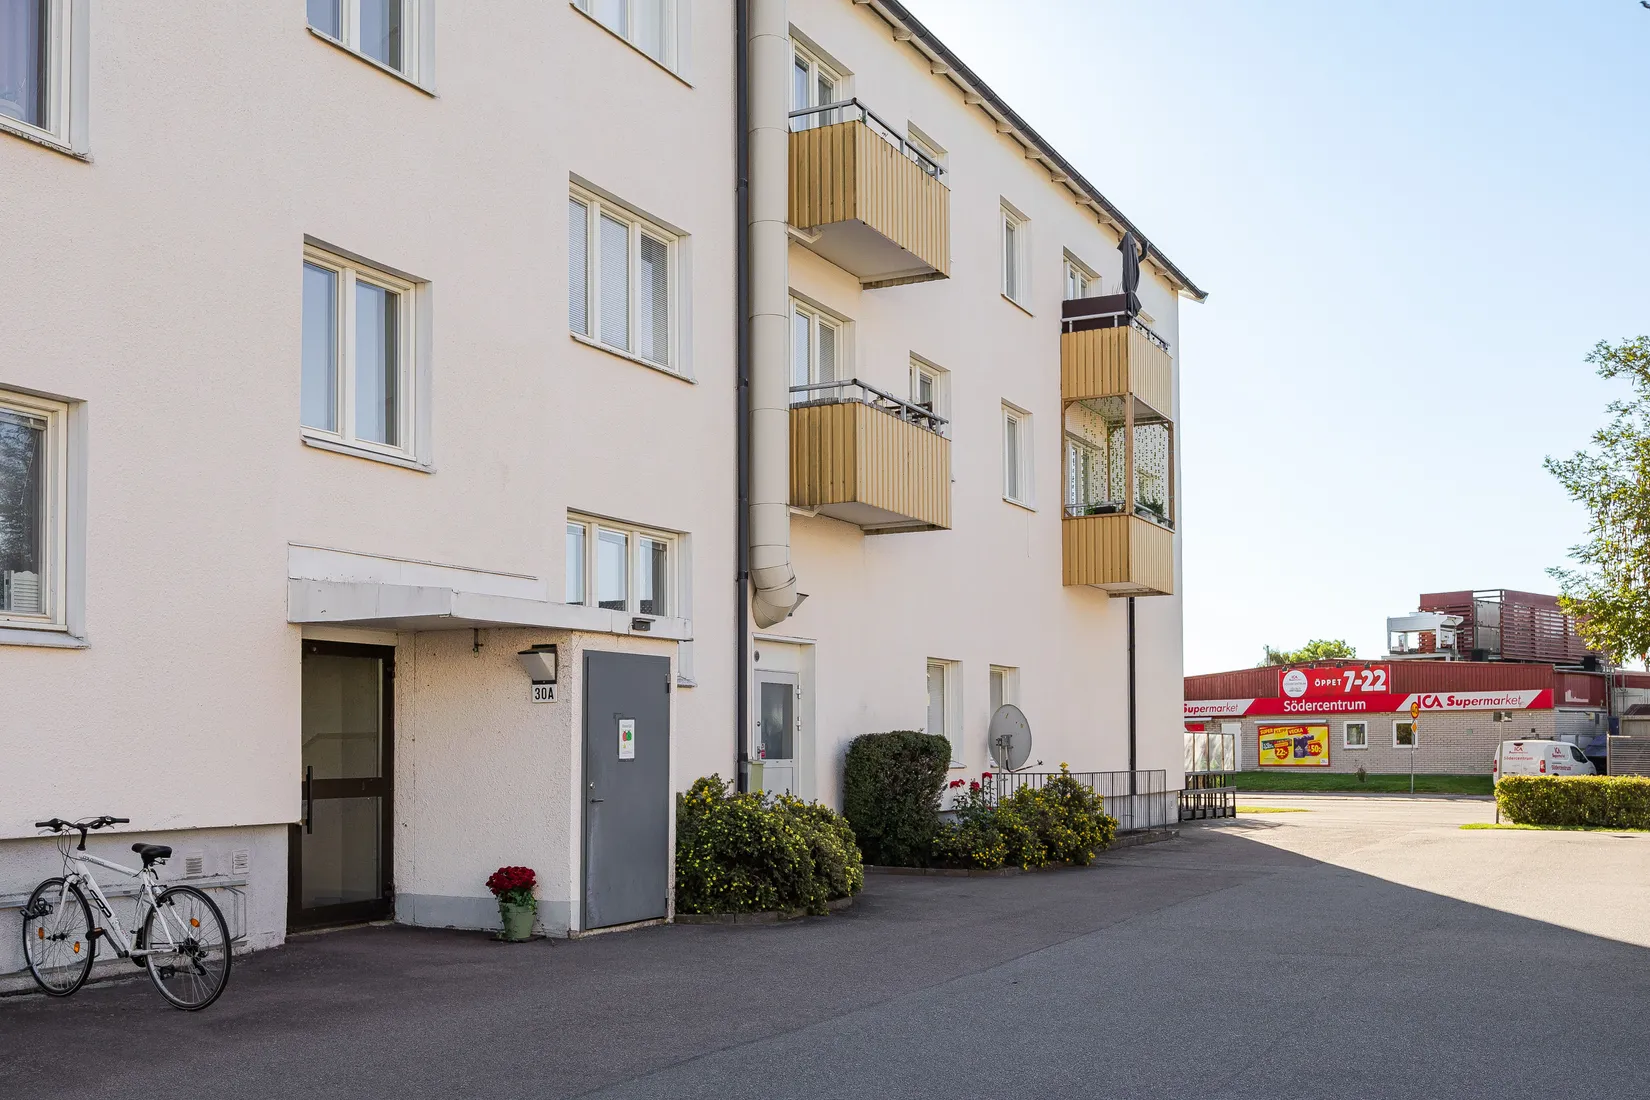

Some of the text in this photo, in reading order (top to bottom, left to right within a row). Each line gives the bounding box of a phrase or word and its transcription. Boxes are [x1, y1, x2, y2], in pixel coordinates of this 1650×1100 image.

[1314, 669, 1386, 692] ÖPPET 7-22
[534, 687, 554, 700] 30A
[1283, 699, 1366, 712] Södercentrum
[1417, 693, 1522, 709] ICA Supermarket
